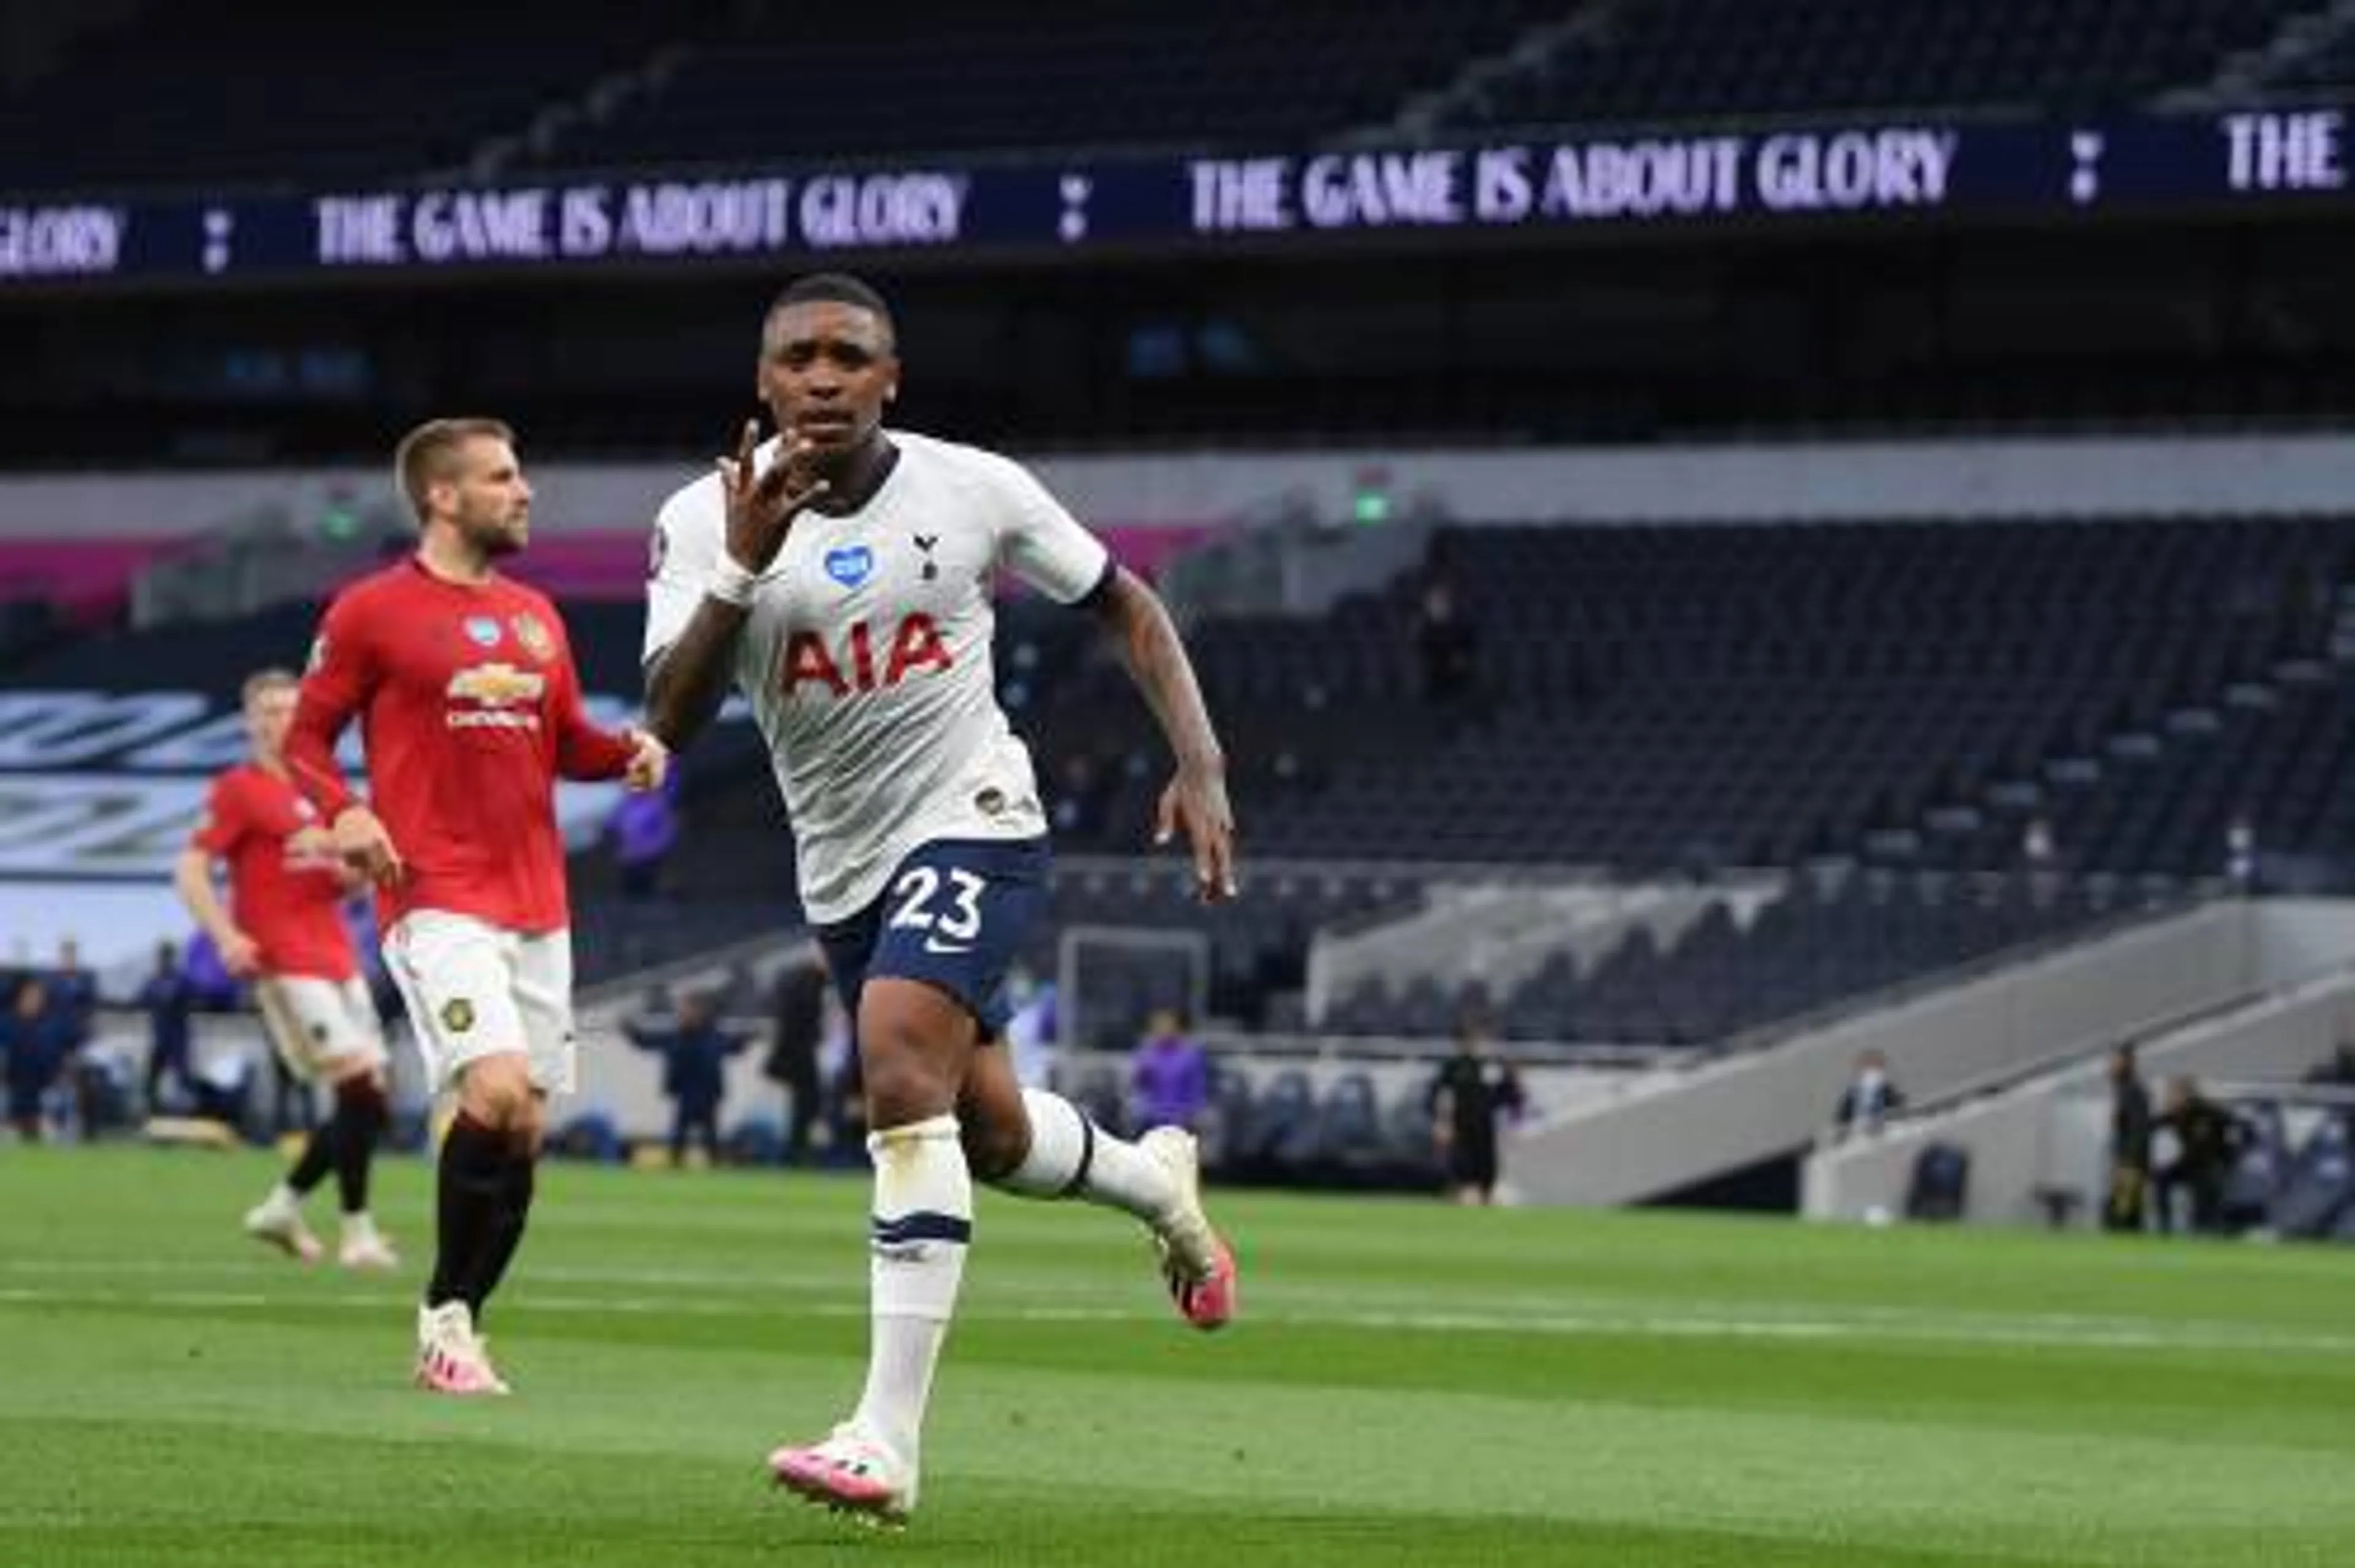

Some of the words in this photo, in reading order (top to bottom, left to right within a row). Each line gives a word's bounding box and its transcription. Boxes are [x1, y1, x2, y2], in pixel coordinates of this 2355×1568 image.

[1189, 157, 1290, 231] THE
[1303, 150, 1464, 228] GAME
[1475, 146, 1531, 223] IS
[1539, 137, 1740, 218] ABOUT
[1755, 126, 1955, 211] GLORY
[2221, 112, 2343, 189] THE
[0, 205, 124, 275] LORY
[316, 193, 405, 264] THE
[413, 187, 545, 261] GAME
[560, 184, 612, 256] IS
[615, 178, 789, 253] ABOUT
[800, 172, 967, 248] GLORY
[781, 612, 954, 697] AIA
[889, 865, 988, 939] 23
